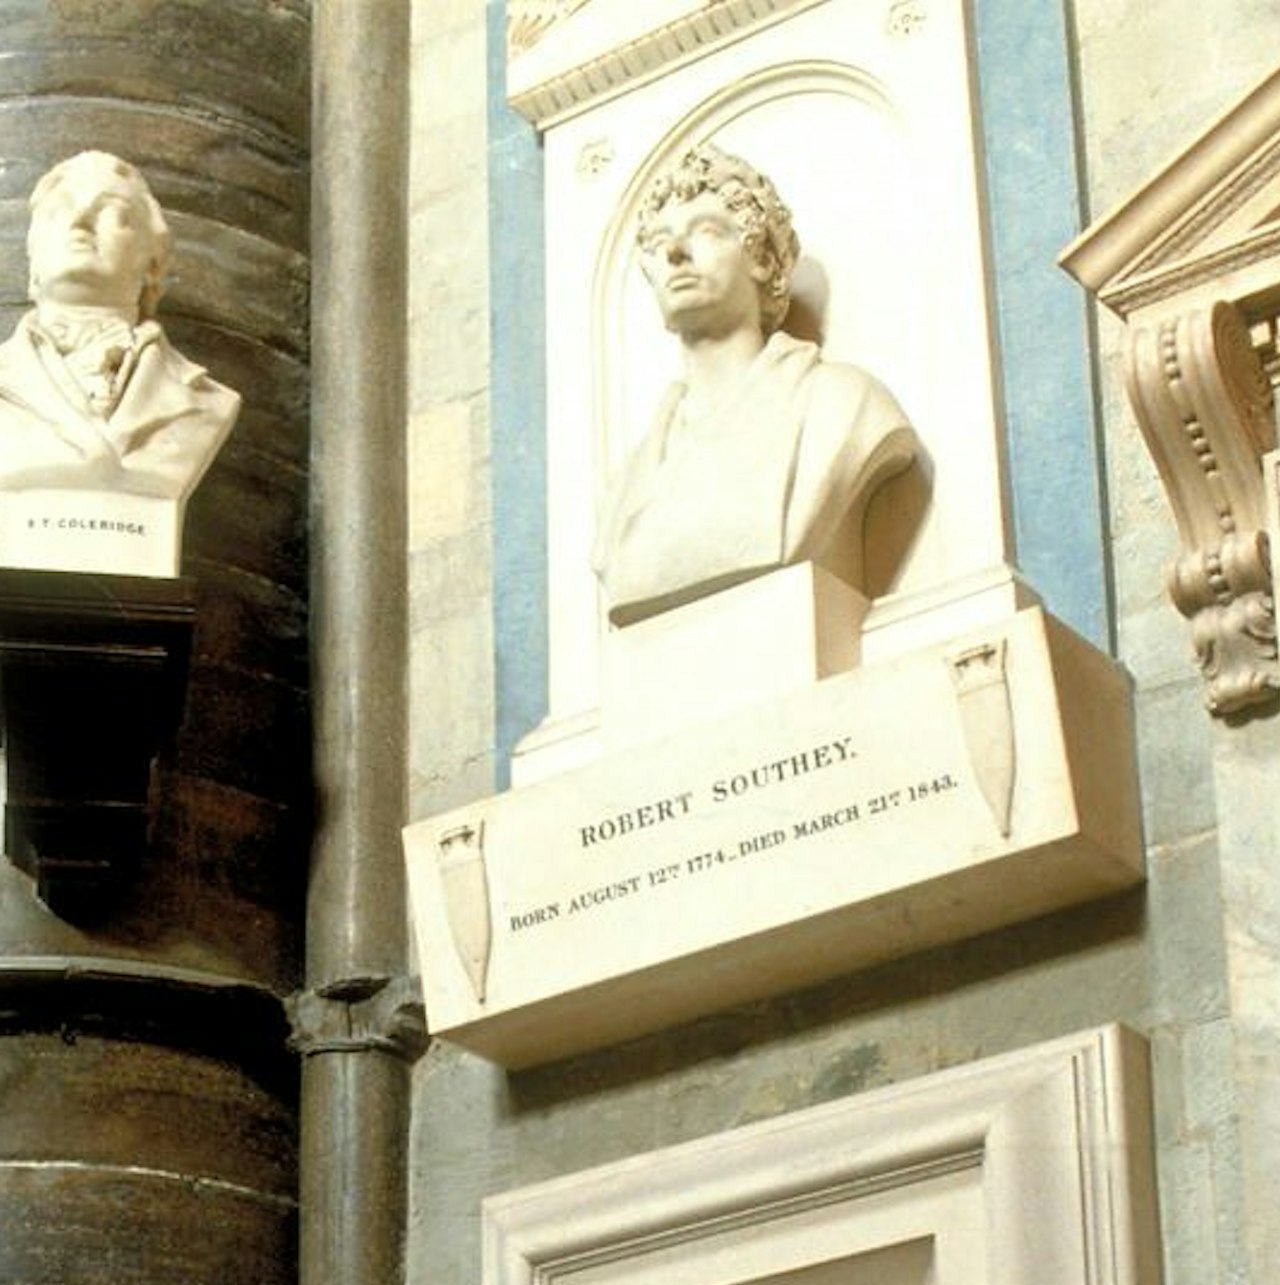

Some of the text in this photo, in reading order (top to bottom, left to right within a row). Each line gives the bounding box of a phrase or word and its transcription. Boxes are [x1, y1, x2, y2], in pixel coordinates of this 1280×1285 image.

[578, 791, 695, 848] ROBERT
[509, 902, 562, 933] BORN
[568, 876, 642, 915] AUGUST
[738, 829, 787, 857] DIED
[792, 804, 861, 840] MARCH
